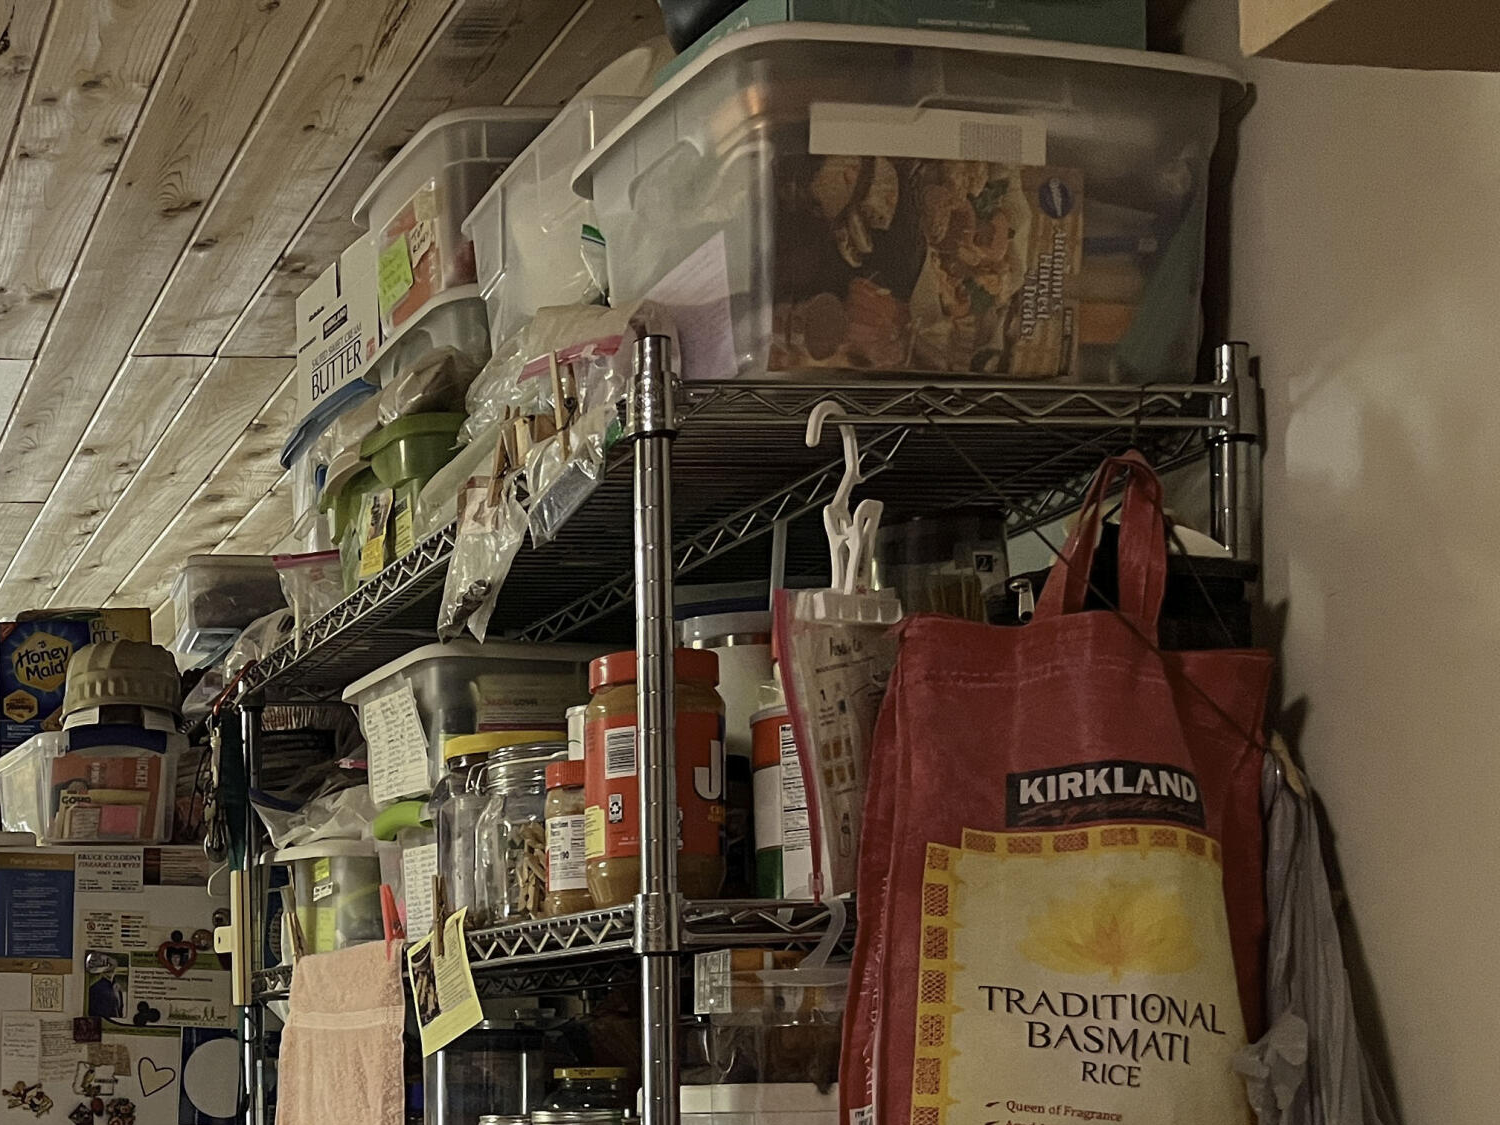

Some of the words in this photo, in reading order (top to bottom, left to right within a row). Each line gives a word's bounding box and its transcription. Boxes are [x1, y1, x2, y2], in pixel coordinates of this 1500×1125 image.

[312, 339, 362, 401] BUTTER
[15, 645, 70, 668] Honey
[26, 659, 65, 681] Maid
[1019, 767, 1197, 805] KIRKLAND
[978, 985, 1226, 1035] TRADITIONAL
[1025, 1021, 1191, 1065] BASMATI
[1081, 1061, 1141, 1088] RICE
[1005, 1100, 1045, 1115] Queen
[1048, 1105, 1062, 1115] of
[1063, 1106, 1123, 1122] Fragrance
